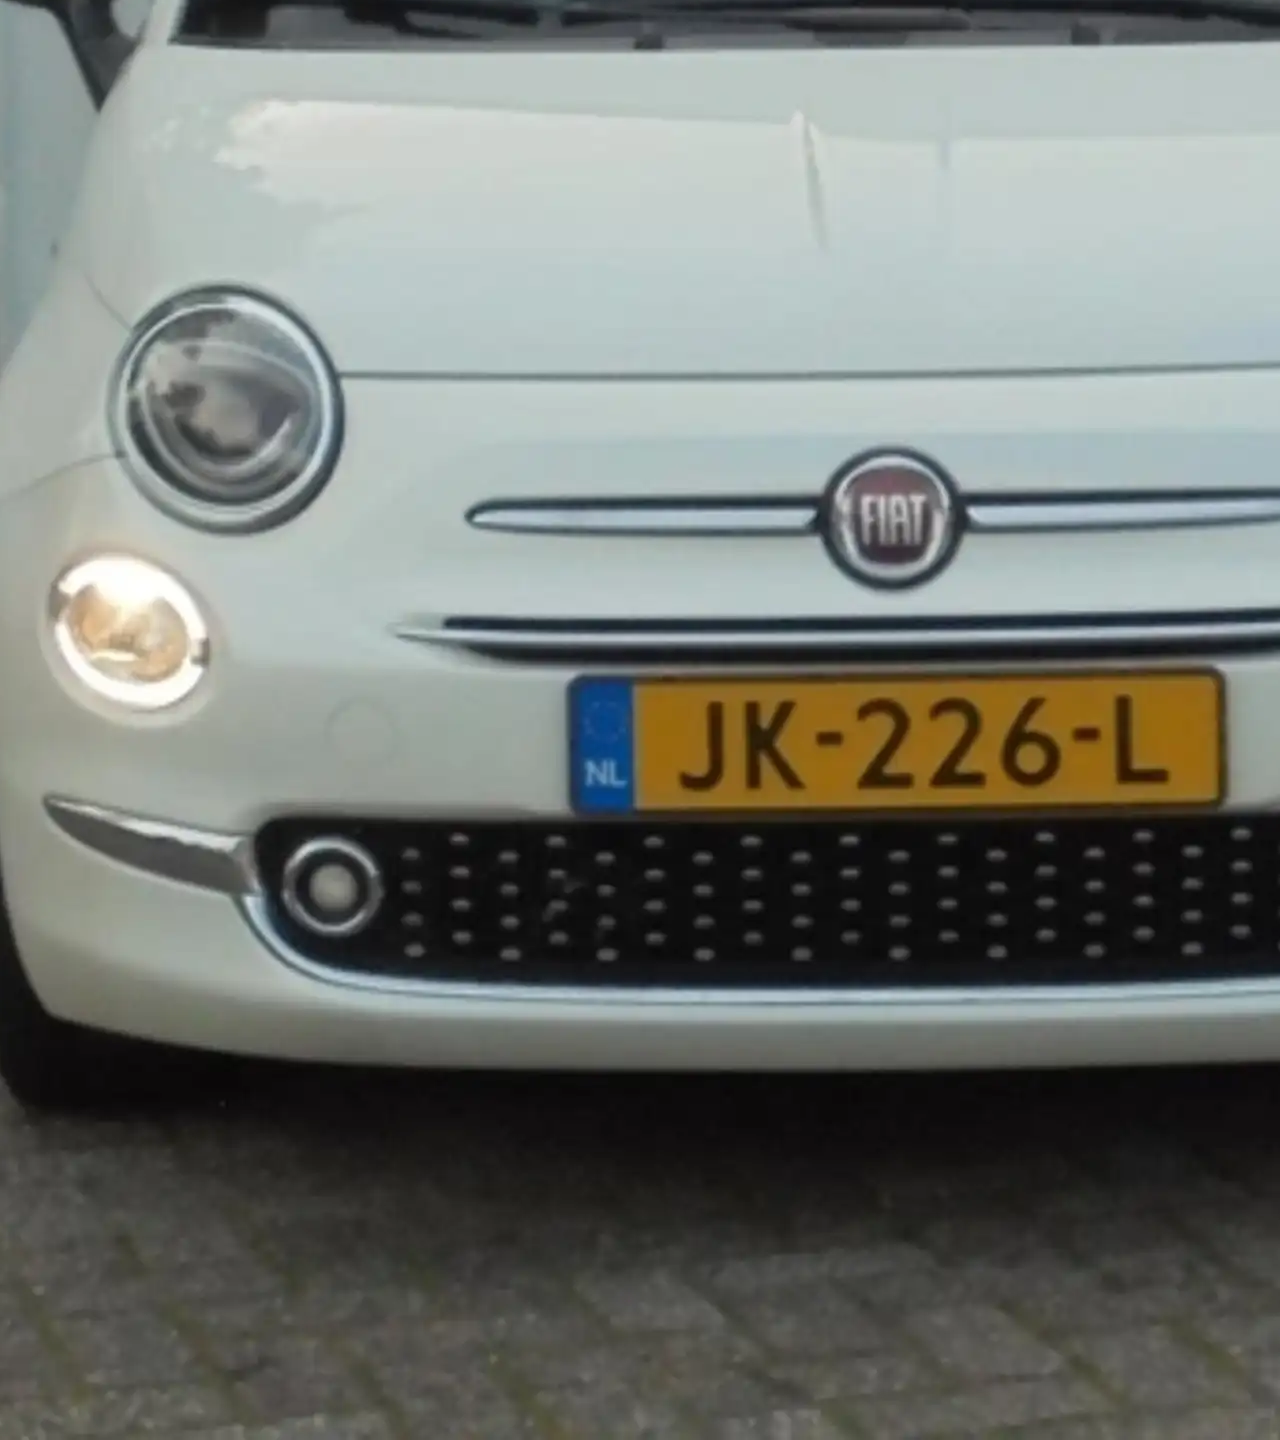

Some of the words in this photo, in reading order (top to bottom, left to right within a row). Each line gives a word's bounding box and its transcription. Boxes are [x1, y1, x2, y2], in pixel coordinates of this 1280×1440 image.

[860, 493, 927, 547] FIAT
[678, 695, 1170, 792] JK-226-L
[584, 759, 627, 789] NL
